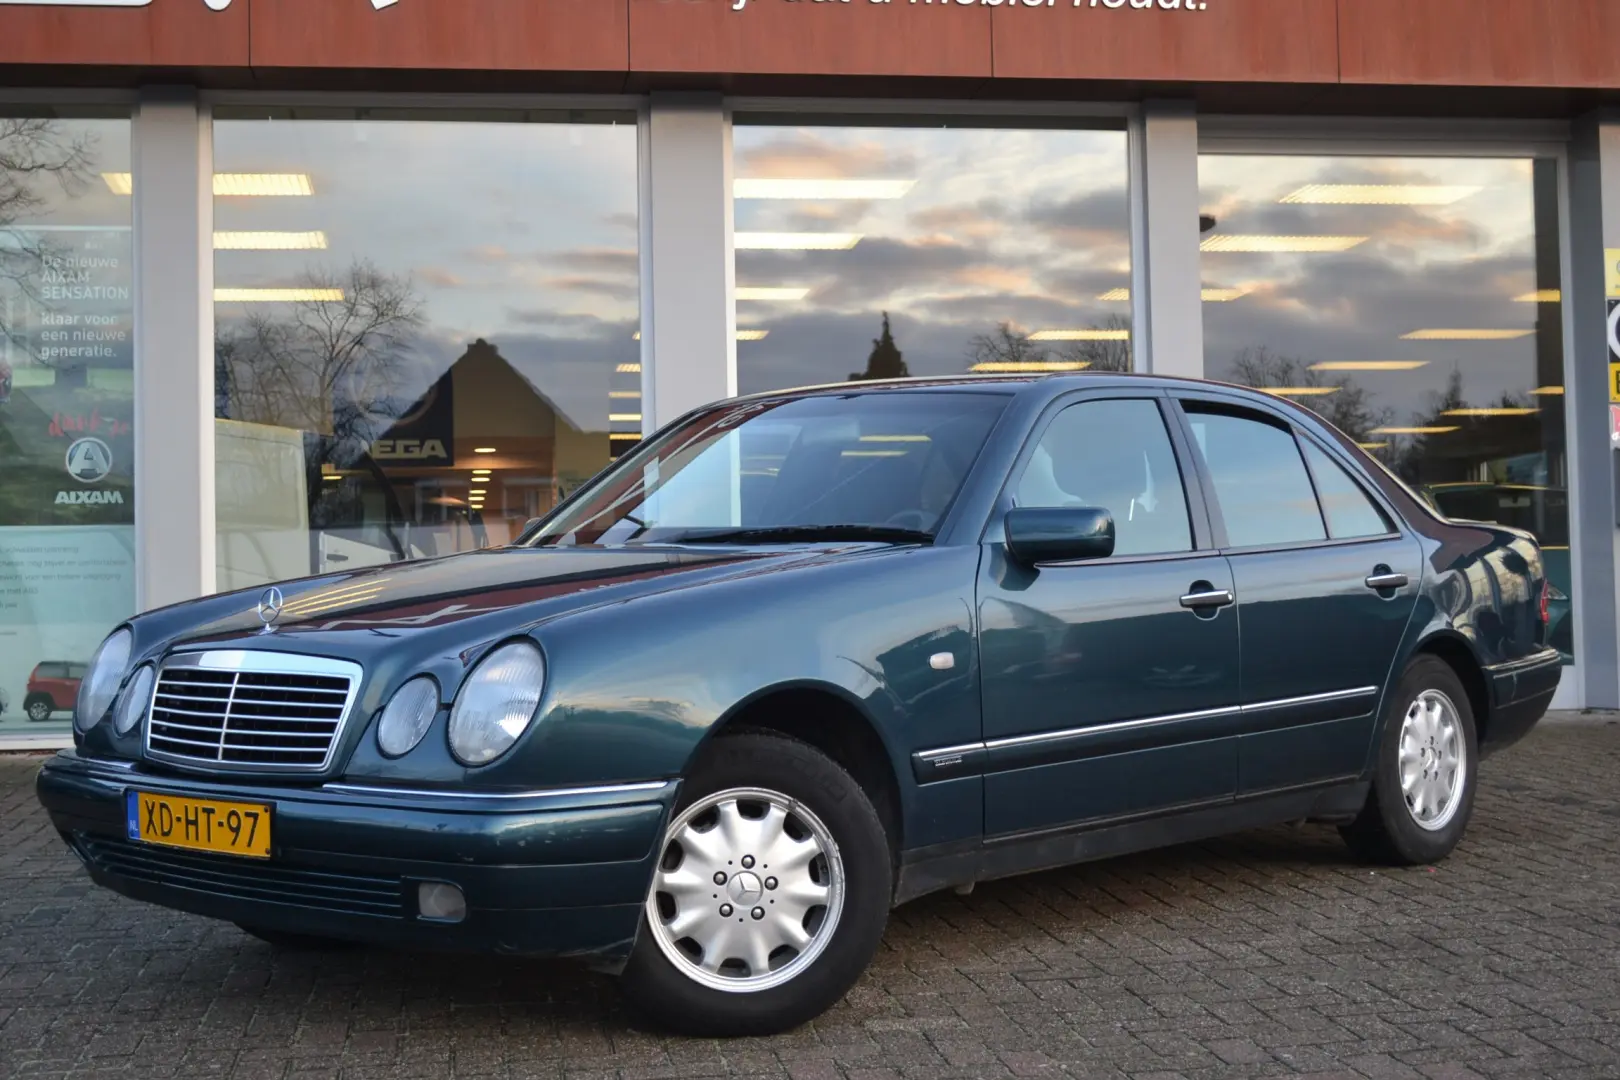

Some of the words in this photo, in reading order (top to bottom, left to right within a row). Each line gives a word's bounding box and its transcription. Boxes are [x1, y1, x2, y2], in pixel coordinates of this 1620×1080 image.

[41, 255, 61, 268] De
[66, 255, 119, 268] nieuwe
[41, 272, 90, 283] AIXAM
[41, 286, 129, 300] SENSATION
[41, 312, 80, 325] klaar
[84, 315, 117, 325] voor
[41, 331, 68, 341] een
[73, 328, 126, 341] nieuwe
[41, 344, 117, 360] generatie.
[54, 490, 124, 504] AIXAM
[129, 819, 139, 831] NL
[144, 799, 260, 848] XD-HT-97
